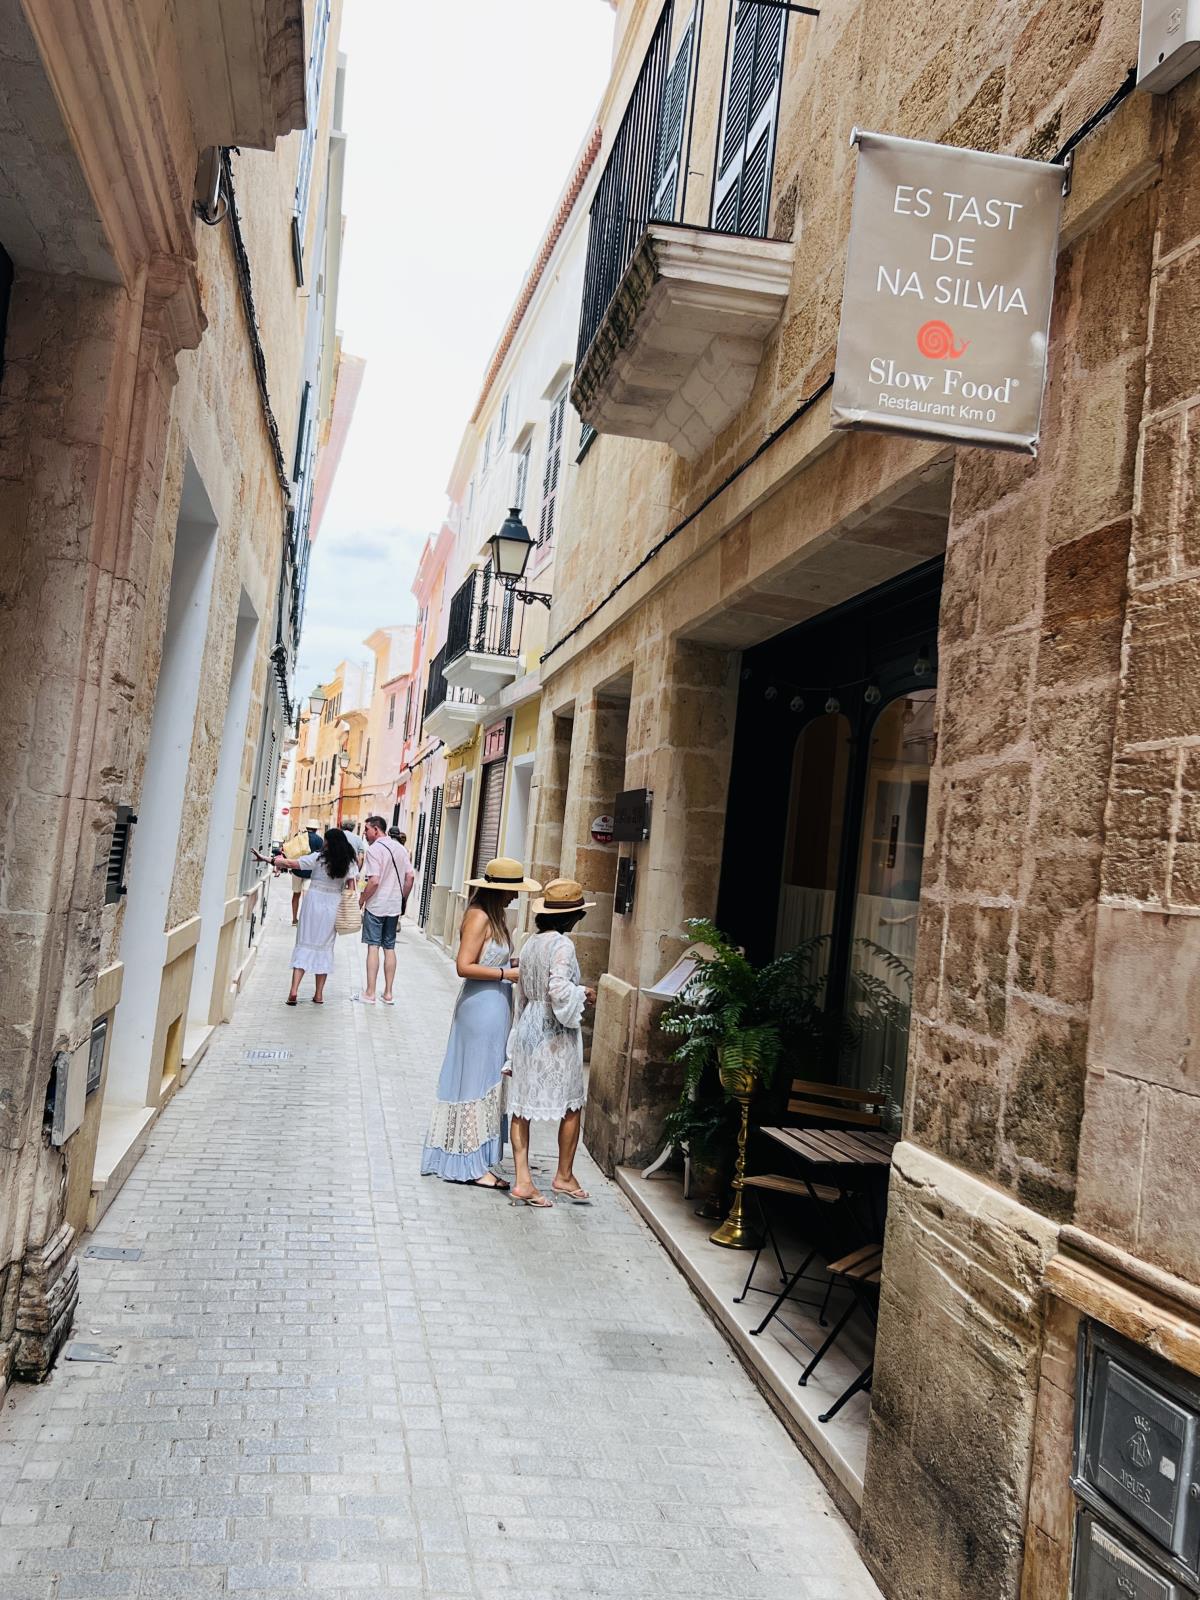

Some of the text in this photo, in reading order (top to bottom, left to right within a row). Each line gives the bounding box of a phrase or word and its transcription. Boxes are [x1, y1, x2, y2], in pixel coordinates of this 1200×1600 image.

[894, 185, 1023, 230] ES TAST
[930, 233, 976, 266] DE
[876, 265, 1028, 315] NA SILVIA
[868, 357, 934, 392] Slow
[878, 393, 996, 423] Restaurant Km 0
